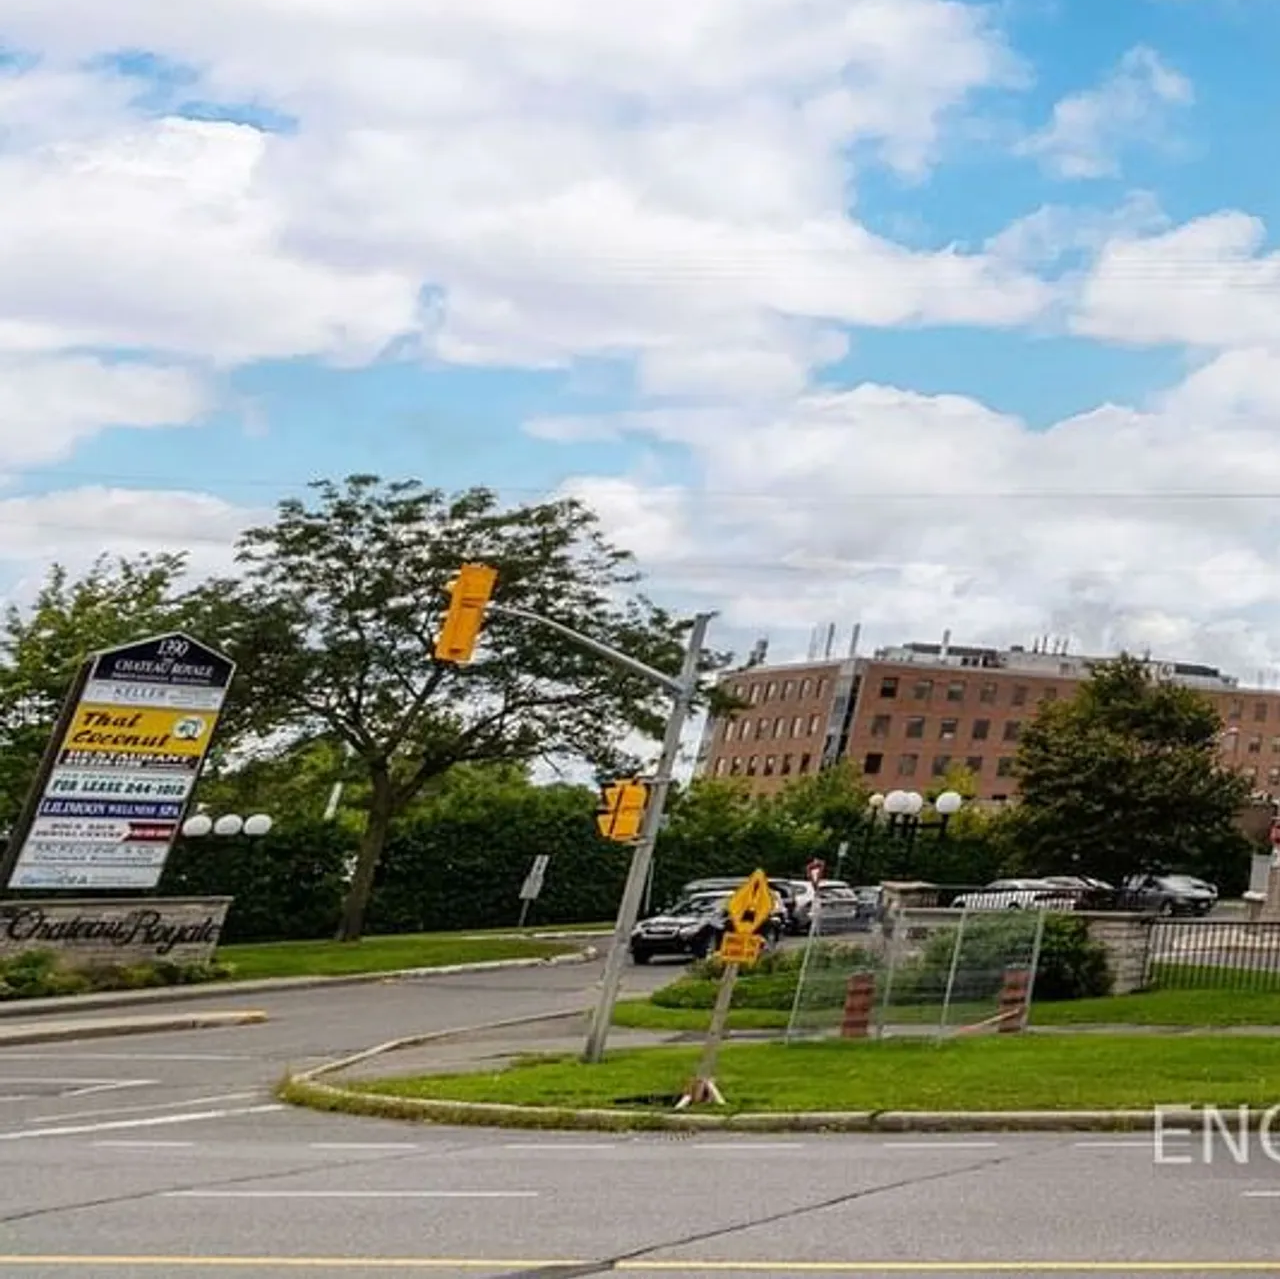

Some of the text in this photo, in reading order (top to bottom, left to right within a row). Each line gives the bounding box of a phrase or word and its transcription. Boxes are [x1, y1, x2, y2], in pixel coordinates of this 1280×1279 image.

[115, 659, 214, 677] CHATEAU ROYALE
[72, 729, 171, 747] Coconut
[52, 779, 78, 791] FOR
[82, 780, 124, 794] LEASE
